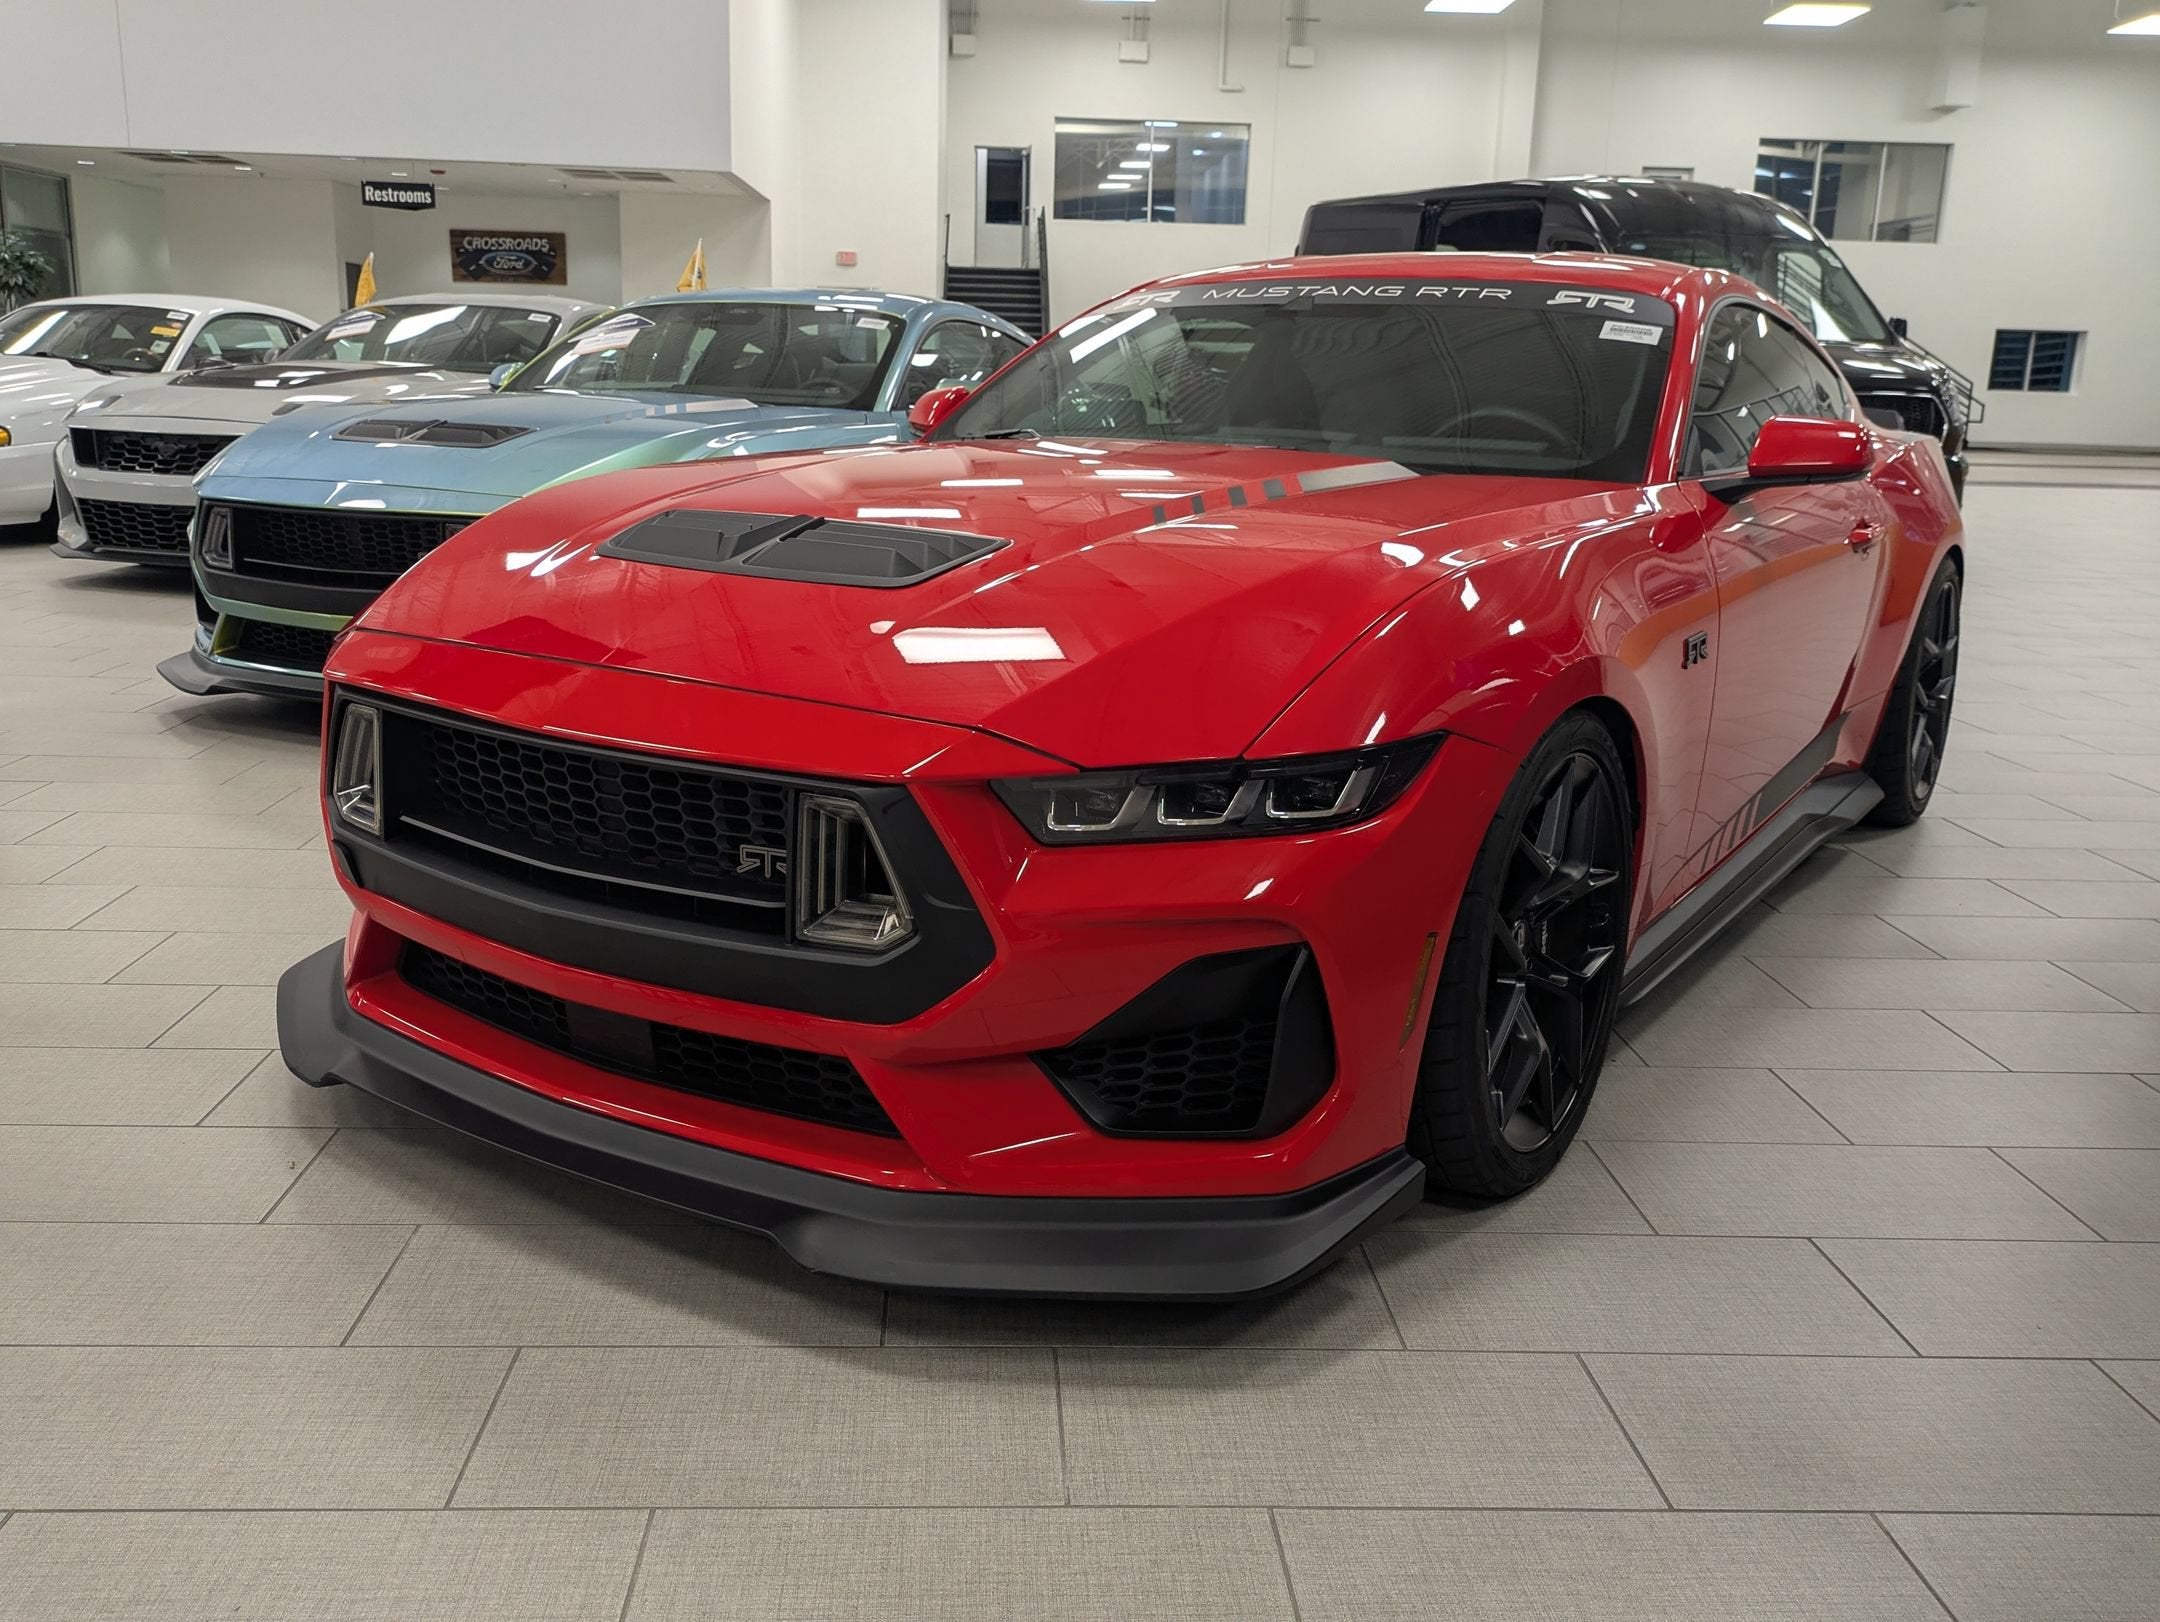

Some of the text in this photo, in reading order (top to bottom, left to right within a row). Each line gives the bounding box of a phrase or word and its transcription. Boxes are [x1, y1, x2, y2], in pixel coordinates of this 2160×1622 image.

[364, 185, 432, 204] Restrooms
[463, 236, 550, 251] CROSSROADS
[493, 255, 526, 269] Ford
[1202, 285, 1513, 301] MUSTANG RTR
[1546, 289, 1636, 314] RTR
